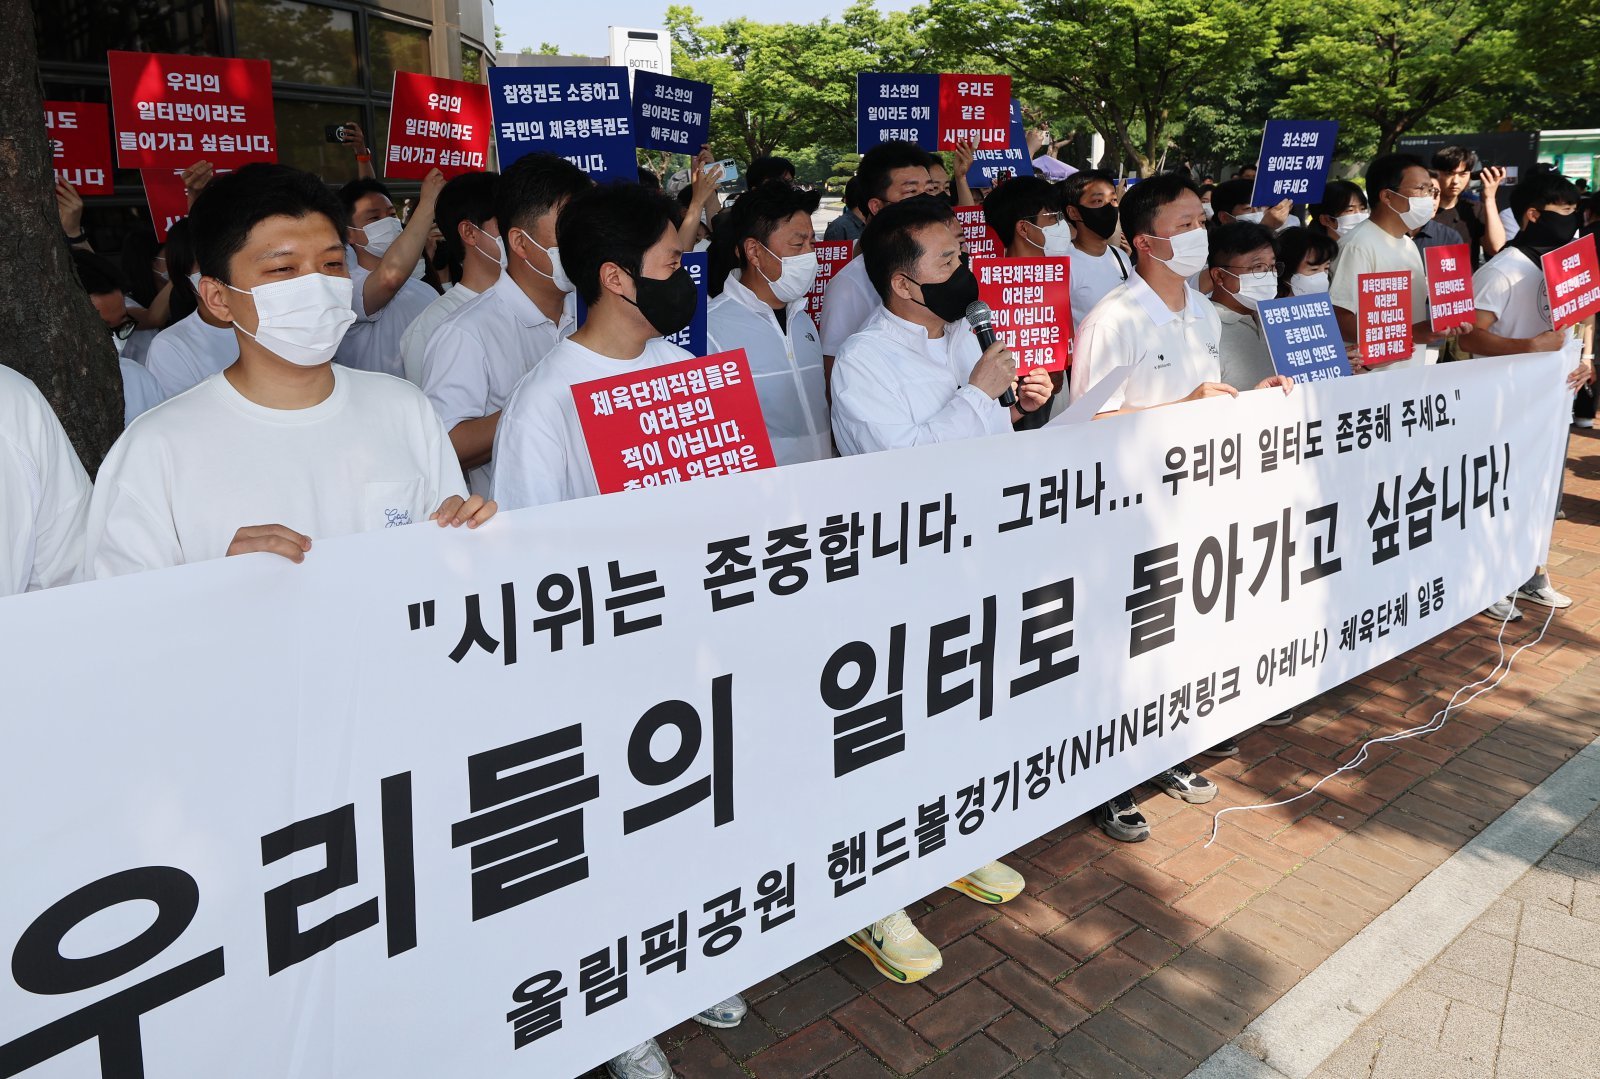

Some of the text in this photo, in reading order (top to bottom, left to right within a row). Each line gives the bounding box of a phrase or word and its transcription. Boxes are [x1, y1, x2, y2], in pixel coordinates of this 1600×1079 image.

[629, 59, 658, 69] BOTTLE
[167, 73, 220, 92] 우리의
[880, 85, 918, 98] 최소한의
[958, 82, 993, 96] 우리도
[504, 83, 619, 103] 참정권도 소중하고
[655, 85, 692, 103] 최소한의
[137, 102, 246, 122] 일터만이라도
[428, 94, 461, 113] 우리의
[962, 106, 984, 119] 같은
[642, 104, 701, 125] 일이라도 하게
[868, 107, 929, 120] 일이라도 하게
[406, 119, 472, 140] 일터만이라도
[502, 118, 629, 141] 국민의 체육행복권도
[651, 127, 688, 143] 해주세요
[879, 128, 919, 142] 해주세요
[119, 131, 273, 152] 들어가고 싶습니다.
[1282, 133, 1318, 147] 최소한의
[389, 144, 483, 167] 들어가고 싶습니다.
[1004, 148, 1023, 161] 하게
[1268, 156, 1324, 171] 일이라도 하게
[1274, 179, 1308, 194] 해주세요
[961, 225, 986, 239] 러분의
[814, 246, 847, 261] 직원들은
[1562, 253, 1581, 272] 우리의
[1440, 257, 1456, 272] 우리의
[981, 264, 1063, 287] 체육단체직원들은
[1362, 276, 1408, 294] 체육단체직원들은
[1555, 270, 1592, 298] 일터만이라도
[1003, 286, 1043, 305] 여러분의
[1434, 278, 1465, 296] 일터만이라도
[1374, 293, 1397, 309] 여러분의
[1431, 298, 1475, 319] 들어가고 싶습니다.
[1552, 299, 1578, 322] 들어가고
[990, 306, 1058, 328] 적이 아닙니다.
[1264, 302, 1330, 324] 정당한 의사표현은
[1367, 308, 1405, 325] 적이 아닙니다.
[1020, 326, 1059, 349] 업무만은
[1285, 324, 1327, 344] 존중합니다.
[1365, 323, 1407, 342] 출입과 업무만은
[1025, 347, 1055, 369] 주세요.
[1287, 345, 1337, 366] 직원의 안전도
[1368, 339, 1405, 358] 보장해 주세요.
[591, 362, 741, 415] 체육단체직원들은
[640, 397, 714, 434] 여러분의
[621, 420, 745, 470] 적이 아닙니다.
[408, 394, 1455, 665] "시위는 존중합니다. 그러나... 우리의 일터도 존중해 주세요."
[0, 443, 1509, 1079] 우리들의 일터로 돌아가고 싶습니다!
[507, 576, 1446, 1050] 올림픽공원 핸드볼경기장(NHN티켓링크 아레나) 체육단체 일동
